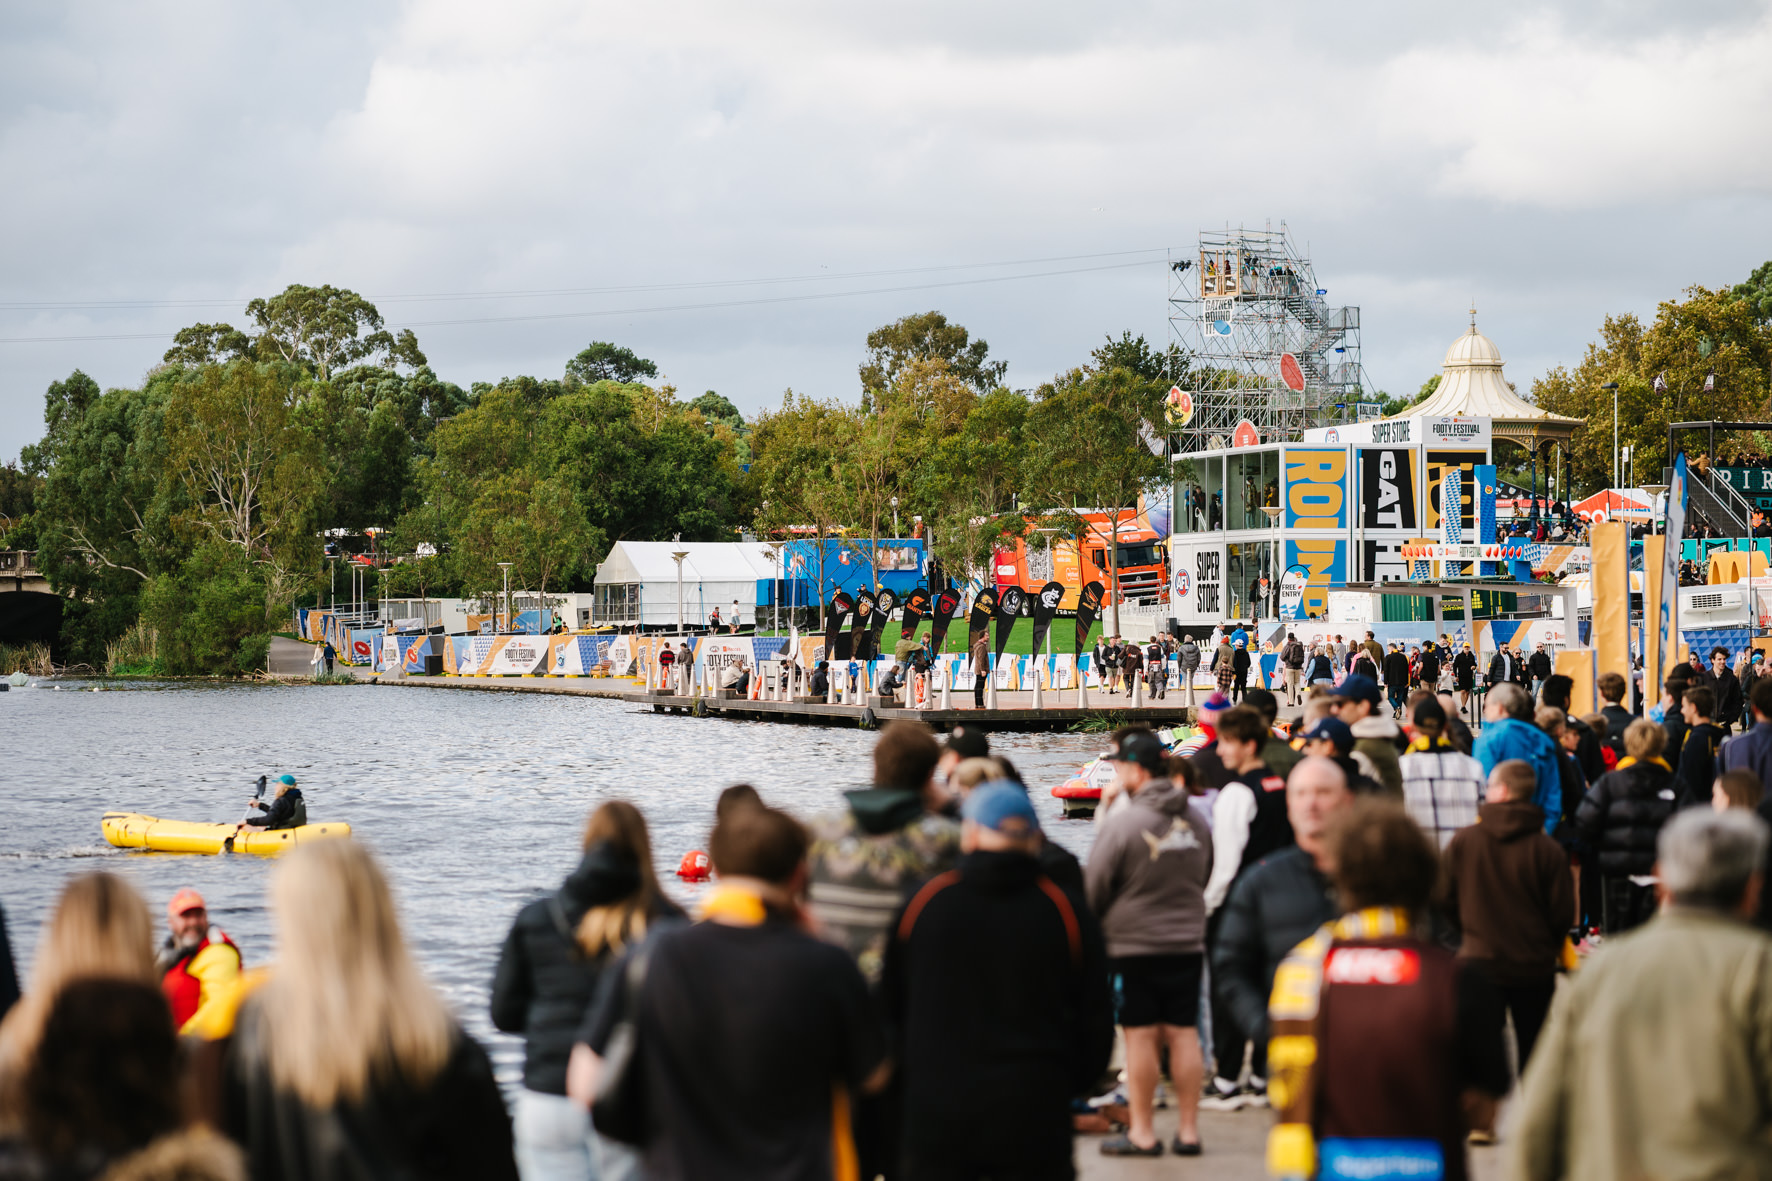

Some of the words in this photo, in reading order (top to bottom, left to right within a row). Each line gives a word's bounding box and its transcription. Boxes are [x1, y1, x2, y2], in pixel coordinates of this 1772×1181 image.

[1205, 299, 1233, 311] GATHER
[1205, 310, 1231, 322] ROUND
[1372, 422, 1391, 443] SUPER
[1391, 420, 1411, 442] STORE
[1432, 424, 1453, 434] FOOTY
[1453, 424, 1481, 434] FESTIVAL
[1374, 451, 1409, 581] GATHE
[1286, 451, 1346, 617] ROUND
[1197, 551, 1219, 581] SUPER
[1177, 577, 1189, 590] AFL
[1197, 583, 1219, 613] STORE
[906, 603, 922, 615] GIANTS
[505, 649, 518, 659] FOOTY
[519, 649, 536, 659] FESTIVAL
